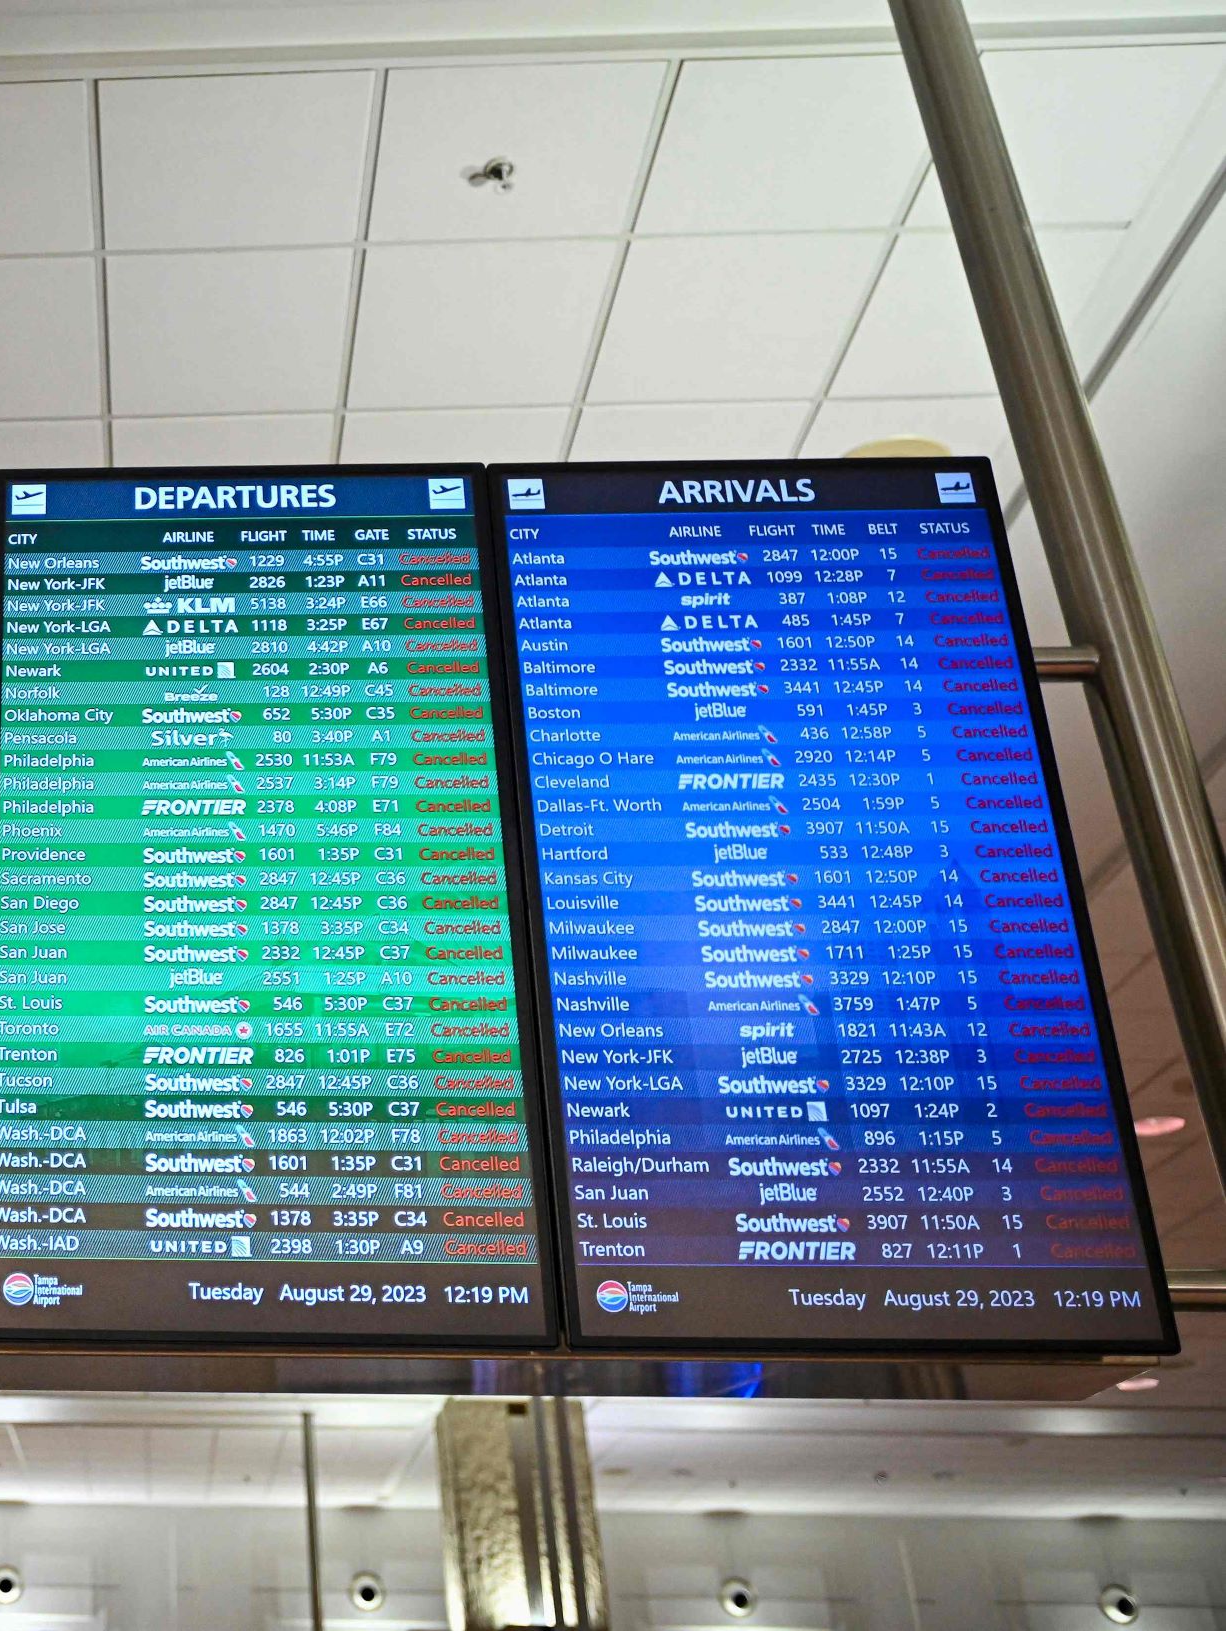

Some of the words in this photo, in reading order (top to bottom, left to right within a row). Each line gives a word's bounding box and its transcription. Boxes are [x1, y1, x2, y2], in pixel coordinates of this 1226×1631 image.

[134, 484, 336, 510] DEPARTURES
[658, 478, 815, 504] ARRIVALS
[8, 533, 37, 546] CITY
[163, 531, 214, 544] AIRLINE
[240, 530, 287, 543] FLIGHT
[302, 529, 335, 542] TIME
[354, 528, 389, 541] GATE
[407, 528, 456, 541] STATUS
[510, 528, 539, 541] CITY
[669, 525, 722, 538] AIRLINE
[749, 523, 796, 537] FLIGHT
[811, 523, 846, 536] TIME
[868, 522, 898, 536] BELT
[919, 522, 970, 535] STATUS
[512, 552, 565, 565] Atlanta
[649, 549, 736, 567] Southwest
[762, 548, 798, 562] 2847
[811, 548, 860, 561] 12:00P
[879, 546, 898, 560] 15
[918, 546, 990, 560] Cancelled
[7, 577, 39, 591] New
[43, 576, 106, 590] York-JFK
[164, 574, 213, 591] jetBlue
[249, 575, 286, 589] 2826
[305, 575, 345, 589] 1:23P
[357, 574, 386, 587] A11
[401, 573, 471, 587] Cancelled
[6, 664, 61, 678] Newark
[146, 666, 214, 677] UNITED
[252, 663, 289, 677] 2604
[309, 662, 350, 676] 2:30P
[367, 661, 389, 675] A6
[407, 660, 479, 674] Cancelled
[534, 774, 610, 790] Cleveland
[678, 774, 785, 789] FRONTIER
[799, 773, 837, 788] 2435
[849, 772, 900, 787] 12:30P
[961, 771, 1038, 786] Cancelled
[2, 847, 86, 862] Providence
[143, 847, 236, 864] Southwest
[259, 847, 296, 862] 1601
[318, 847, 360, 862] 1:35P
[374, 847, 404, 861] C31
[419, 847, 495, 861] Cancelled
[549, 920, 635, 936] Milwaukee
[698, 919, 794, 938] Southwest
[822, 920, 860, 935] 2847
[874, 920, 927, 935] 12:00P
[949, 919, 968, 934] 15
[990, 919, 1069, 934] Cancelled
[572, 1156, 710, 1175] Raleigh/Durham
[729, 1157, 829, 1177] Southwest
[858, 1158, 901, 1175] 2332
[912, 1158, 971, 1174] 11:55A
[991, 1158, 1013, 1174] 14
[1035, 1157, 1119, 1174] Cancelled
[146, 1208, 244, 1228] Southwest
[270, 1210, 311, 1227] 1378
[333, 1210, 379, 1227] 3:35P
[394, 1210, 428, 1228] C34
[443, 1211, 525, 1228] Cancelled
[189, 1283, 264, 1305] Tuesday
[280, 1284, 346, 1306] August
[351, 1285, 376, 1305] 29,
[382, 1286, 427, 1303] 2023
[445, 1287, 494, 1304] 12:19
[499, 1287, 529, 1304] PM
[627, 1281, 653, 1295] Tampa
[629, 1292, 679, 1305] International
[789, 1289, 866, 1311] Tuesday
[884, 1290, 951, 1311] August
[957, 1290, 983, 1310] 29,
[991, 1290, 1035, 1308] 2023
[1054, 1290, 1103, 1308] 12:19
[1109, 1290, 1141, 1308] PM
[629, 1302, 657, 1315] Airport
